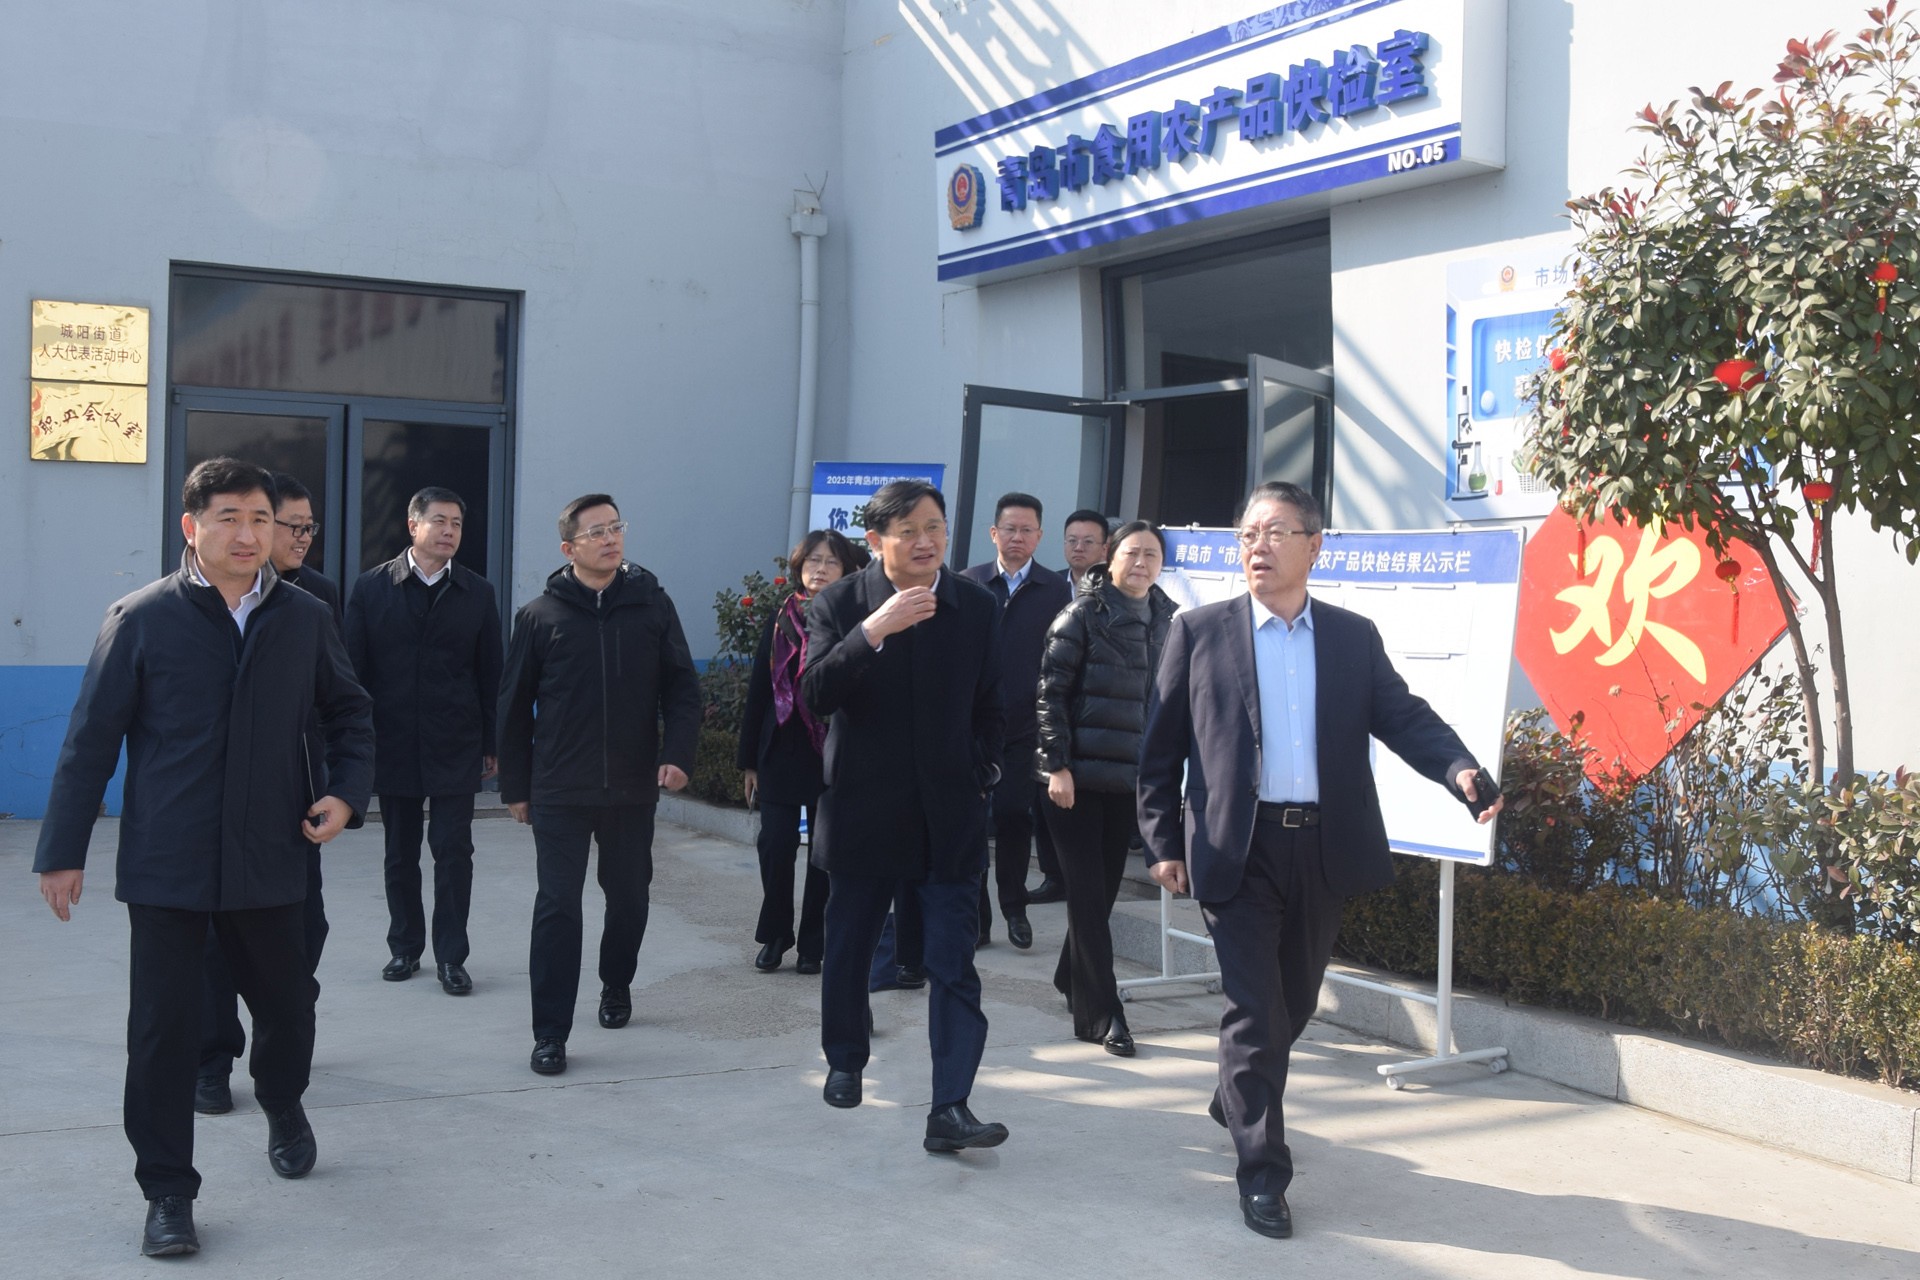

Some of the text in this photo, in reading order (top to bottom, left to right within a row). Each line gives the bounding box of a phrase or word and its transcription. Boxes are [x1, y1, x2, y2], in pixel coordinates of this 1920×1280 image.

[995, 29, 1429, 212] 青岛市食用农产品快检室
[1387, 141, 1445, 172] NO.05
[1535, 264, 1579, 288] 市场
[60, 323, 122, 342] 城阳街道
[39, 344, 142, 364] 人大代表活动中心
[1494, 333, 1570, 363] 快检保
[1312, 549, 1472, 573] 农产品快检结果公示栏
[1549, 500, 1707, 685] 欢
